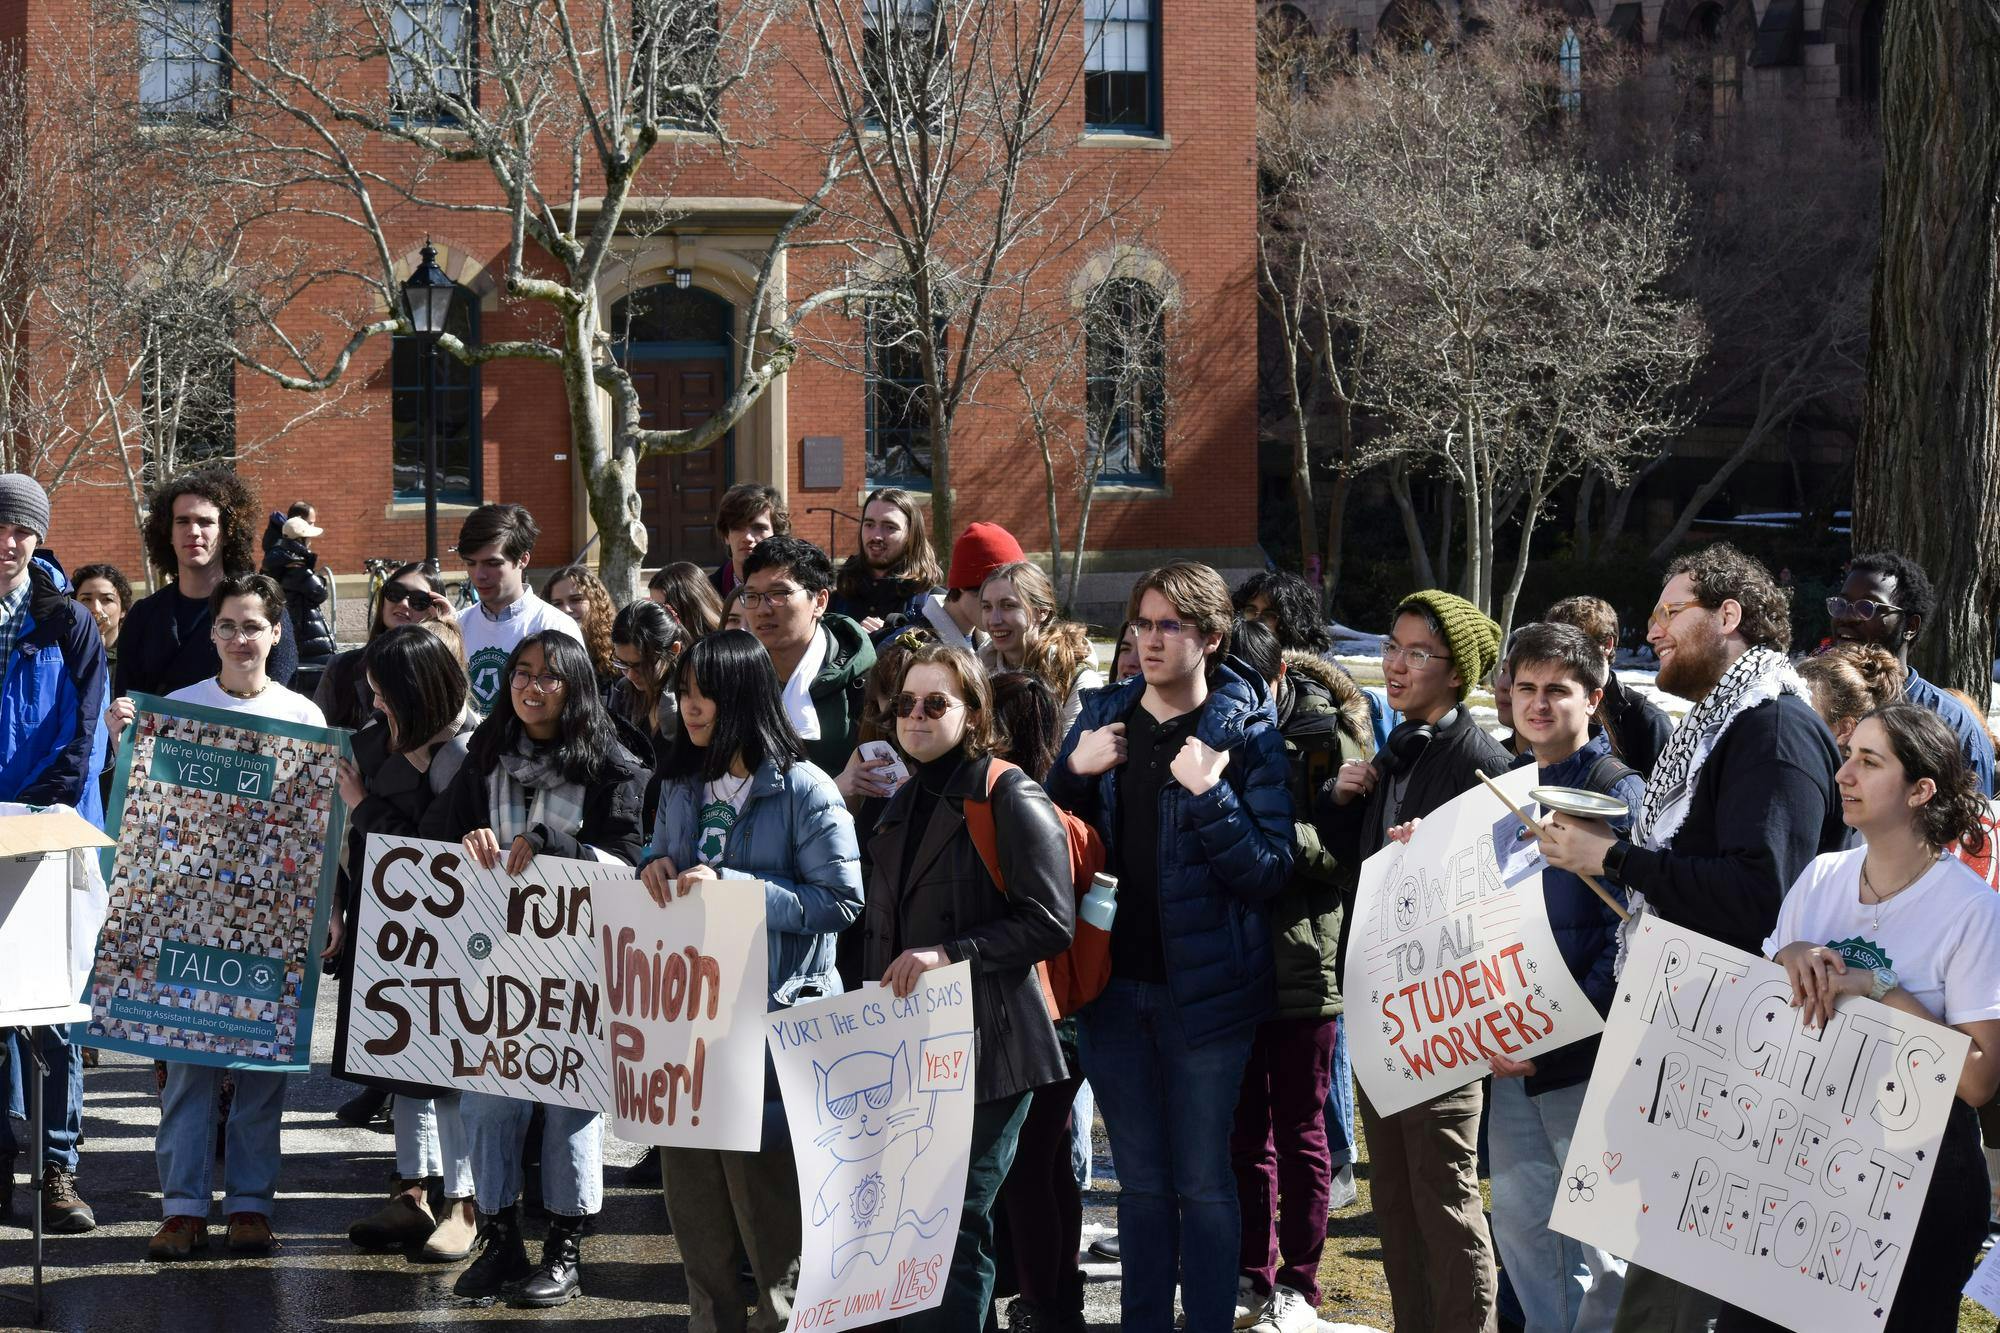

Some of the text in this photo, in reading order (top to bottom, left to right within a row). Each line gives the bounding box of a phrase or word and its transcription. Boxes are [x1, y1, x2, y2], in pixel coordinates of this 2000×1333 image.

[160, 742, 269, 772] We're Voting Union
[178, 761, 220, 786] YES!
[372, 846, 595, 938] CS run
[1380, 834, 1502, 942] POWER
[166, 948, 242, 986] TALO
[376, 920, 439, 970] on
[602, 924, 720, 1022] Union
[1387, 914, 1484, 982] TO ALL
[114, 1004, 272, 1036] Teaching Assistant Labor Organization
[364, 975, 604, 1056] STUDEN
[772, 981, 963, 1050] YURT THE CS CAT SAYS
[1382, 942, 1528, 1045] STUDENT
[452, 1038, 584, 1092] LABOR
[610, 1021, 706, 1126] Power!
[924, 1050, 962, 1082] YES!
[1400, 994, 1554, 1081] WORKERS
[1640, 938, 1945, 1131] RIGHTS
[1648, 1050, 1914, 1220] RESPECT
[1677, 1156, 1900, 1302] REFORM
[794, 1254, 942, 1333] VOTE UNION YES
